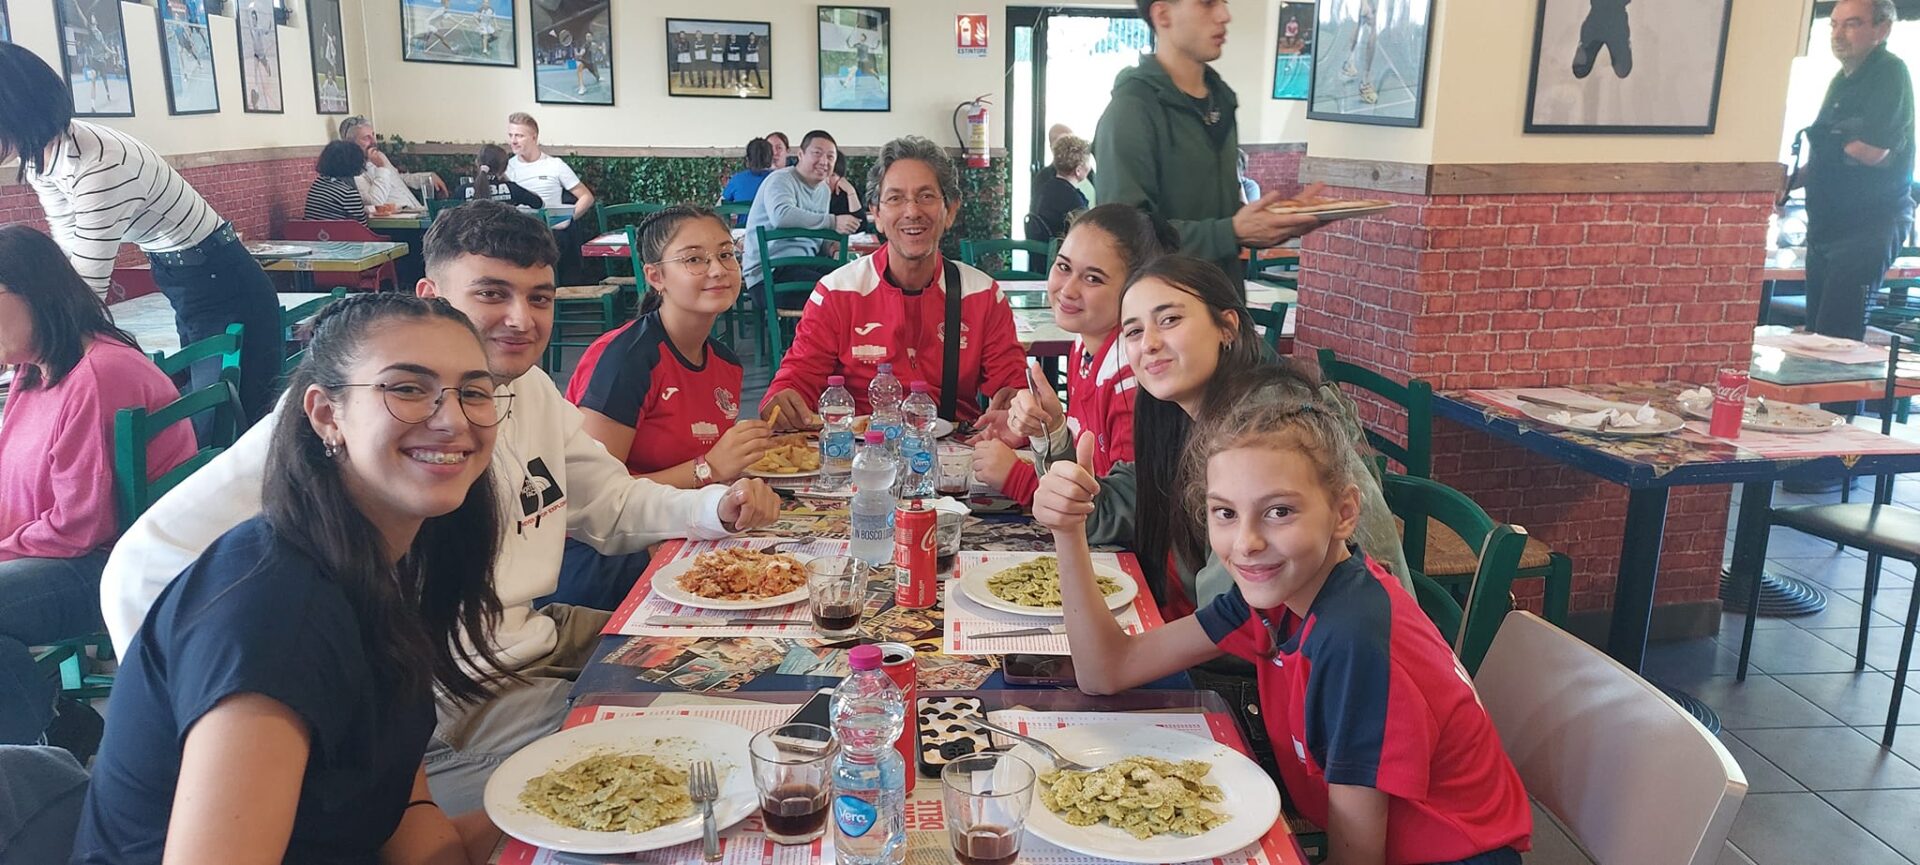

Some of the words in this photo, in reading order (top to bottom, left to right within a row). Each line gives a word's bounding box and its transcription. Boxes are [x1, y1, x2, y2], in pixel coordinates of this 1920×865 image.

[861, 530, 882, 540] BOSCO
[838, 805, 868, 823] Vera
[918, 800, 944, 830] DELLE
